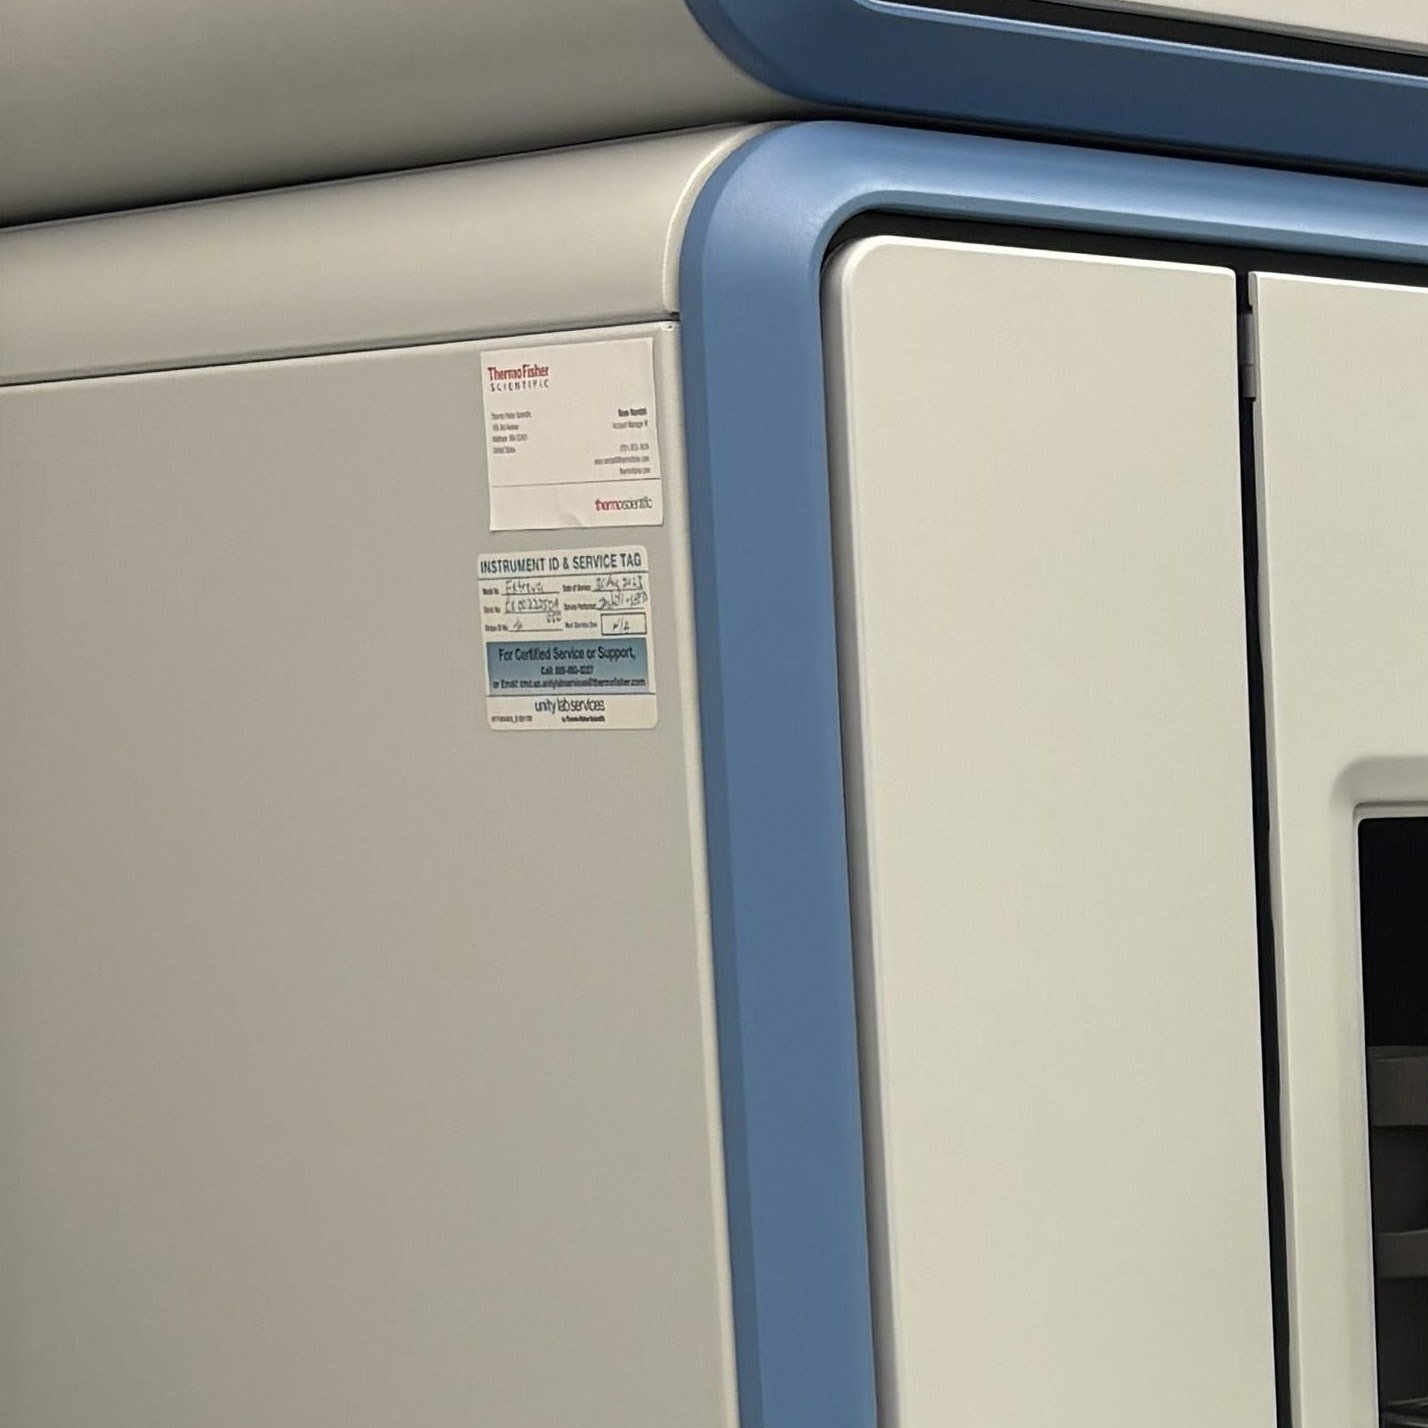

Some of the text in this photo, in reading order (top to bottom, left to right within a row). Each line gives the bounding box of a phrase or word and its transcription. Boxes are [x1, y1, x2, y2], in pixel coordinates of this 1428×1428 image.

[490, 379, 549, 392] SCIENTIFIC
[480, 552, 642, 573] INSTRUMENT ID & SERVICE TAG
[499, 648, 514, 661] For
[515, 647, 550, 661] Certified
[553, 646, 585, 661] Service
[586, 649, 595, 658] or
[534, 699, 556, 715] unity
